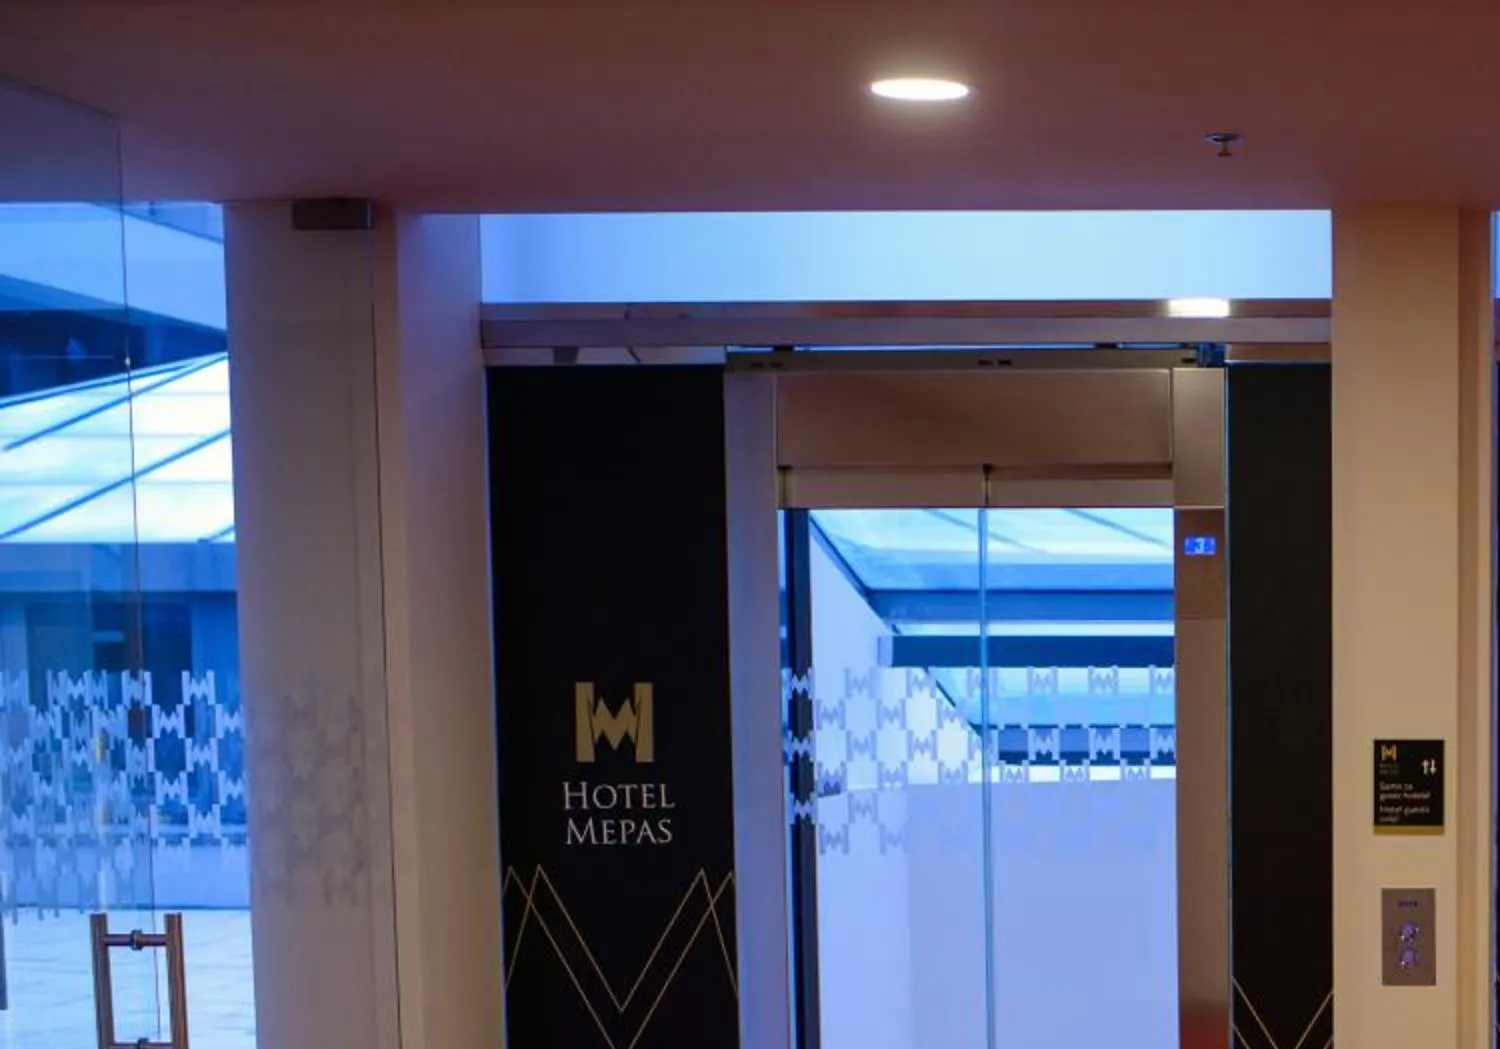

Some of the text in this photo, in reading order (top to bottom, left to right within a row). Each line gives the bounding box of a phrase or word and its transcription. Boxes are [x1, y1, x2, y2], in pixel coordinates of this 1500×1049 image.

[1194, 536, 1206, 555] 3
[562, 781, 677, 811] HOTEL
[564, 816, 673, 845] MEPAS
